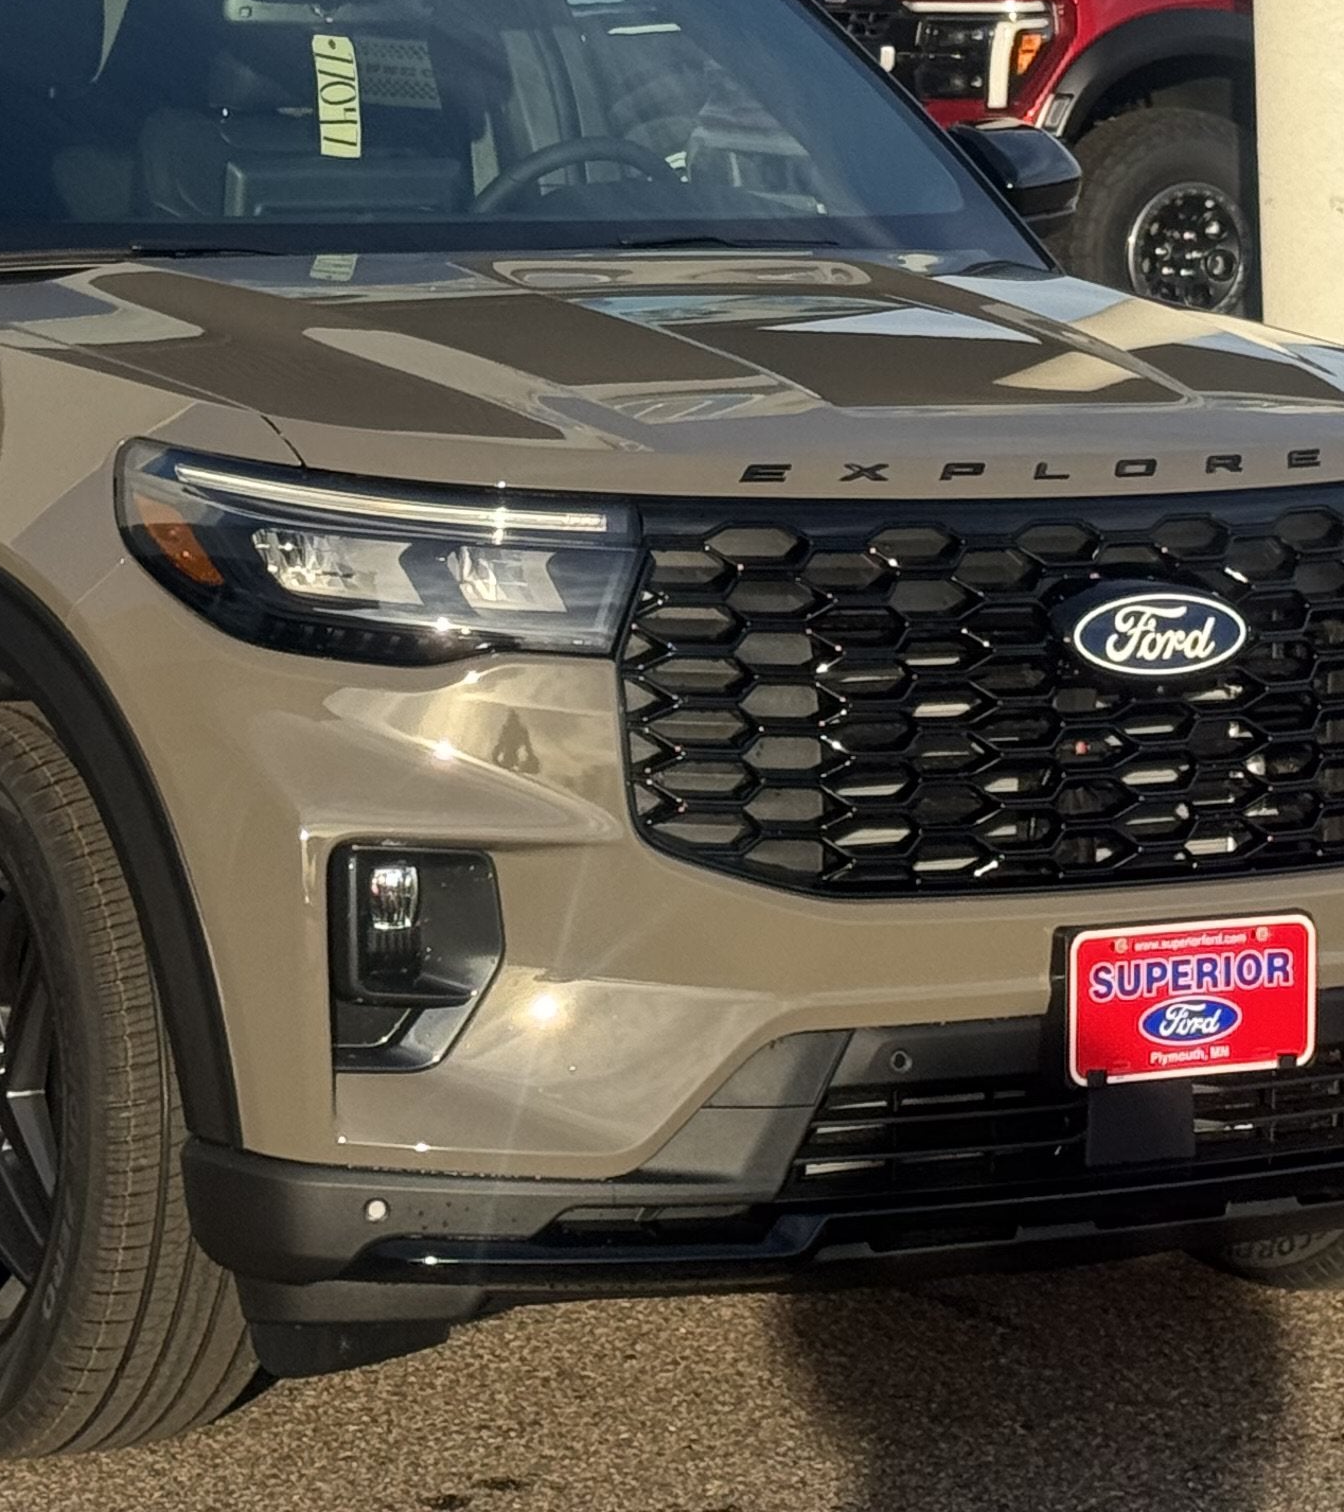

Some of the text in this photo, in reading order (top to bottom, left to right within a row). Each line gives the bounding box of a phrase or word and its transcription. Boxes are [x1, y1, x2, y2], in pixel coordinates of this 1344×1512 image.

[1105, 600, 1216, 663] Ford
[1134, 932, 1247, 951] www.superiorford.com
[1090, 948, 1294, 1002] SUPERIOR
[1158, 1002, 1223, 1037] Ford
[1210, 1045, 1230, 1059] MN
